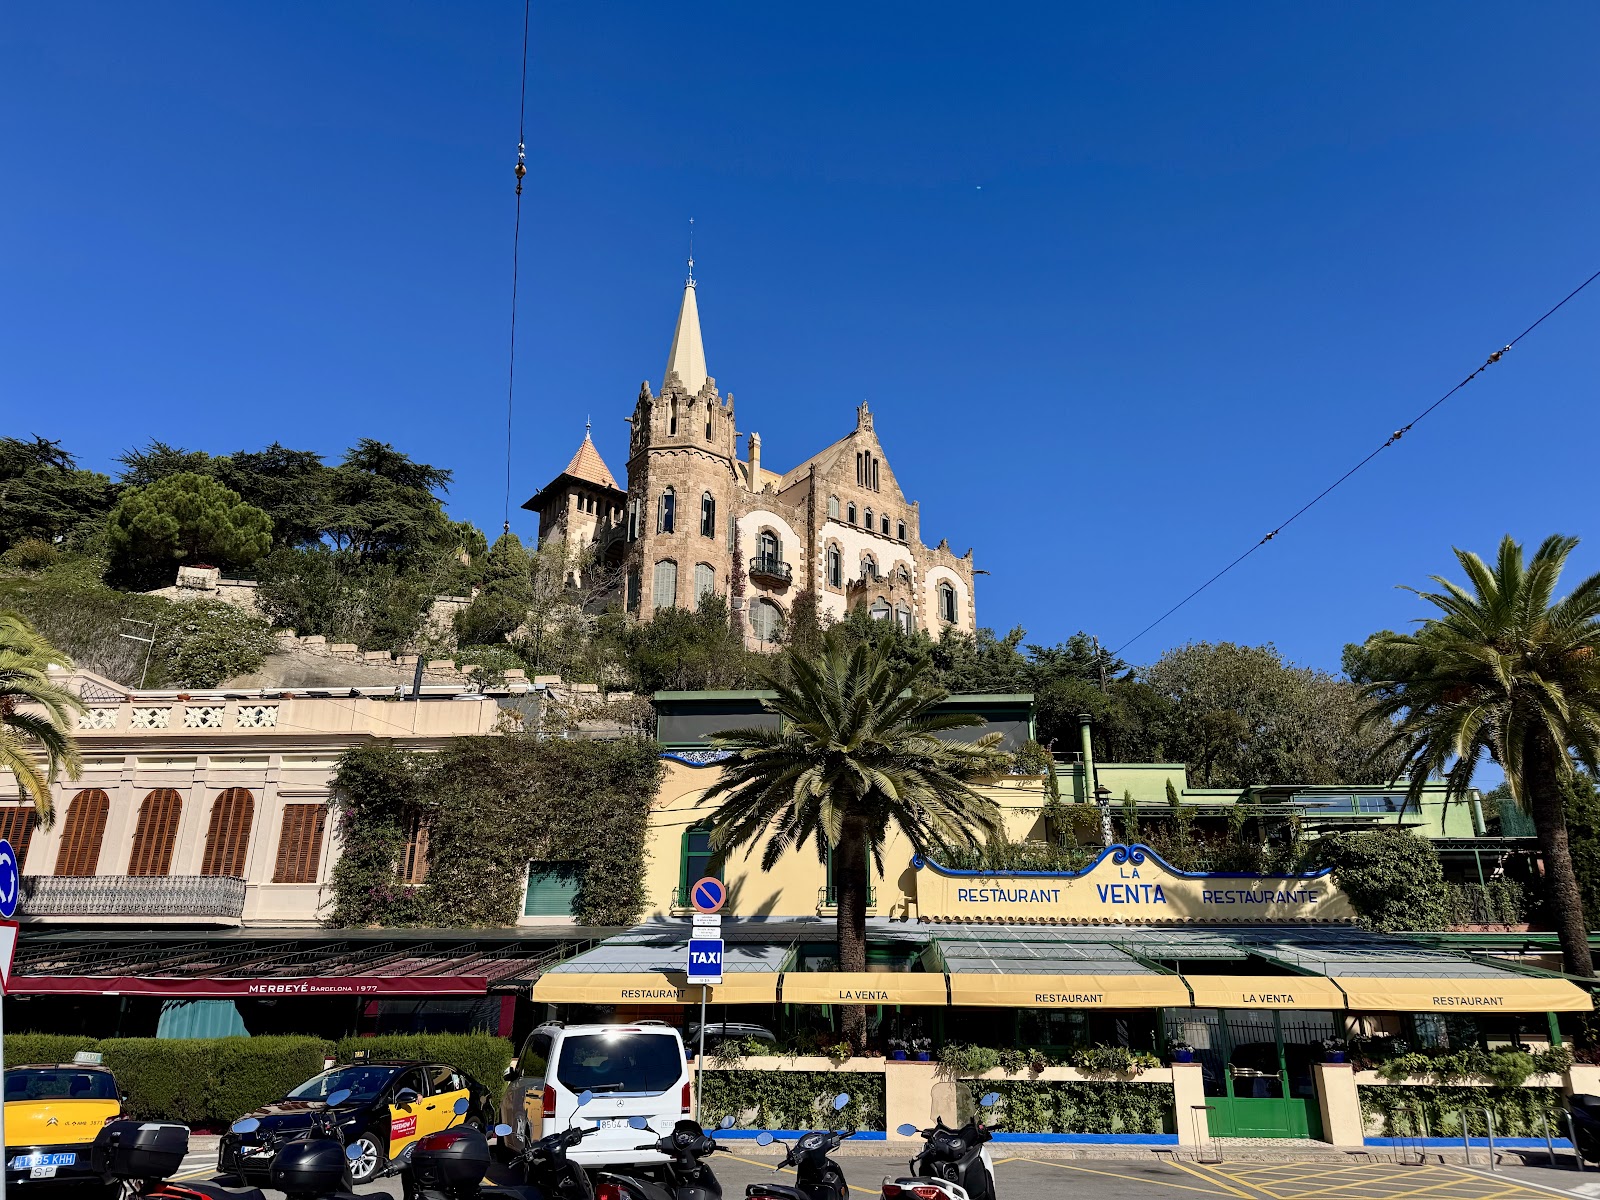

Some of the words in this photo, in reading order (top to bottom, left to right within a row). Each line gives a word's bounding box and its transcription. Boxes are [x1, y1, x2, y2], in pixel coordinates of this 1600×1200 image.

[1120, 867, 1140, 879] LA
[958, 888, 1061, 903] RESTAURANT
[1096, 883, 1166, 904] VENTA
[1202, 889, 1319, 904] RESTAURANTE
[690, 951, 721, 964] TAXI
[248, 982, 308, 993] MERBEYÉ
[621, 989, 686, 998] RESTAURANT
[839, 990, 852, 999] LA
[855, 990, 889, 1000] VENTA
[1035, 993, 1104, 1003] RESTAURANT
[1242, 993, 1257, 1003] LA
[1264, 993, 1295, 1004] VENTA
[1432, 996, 1504, 1006] RESTAURANT
[52, 1154, 73, 1165] KHH
